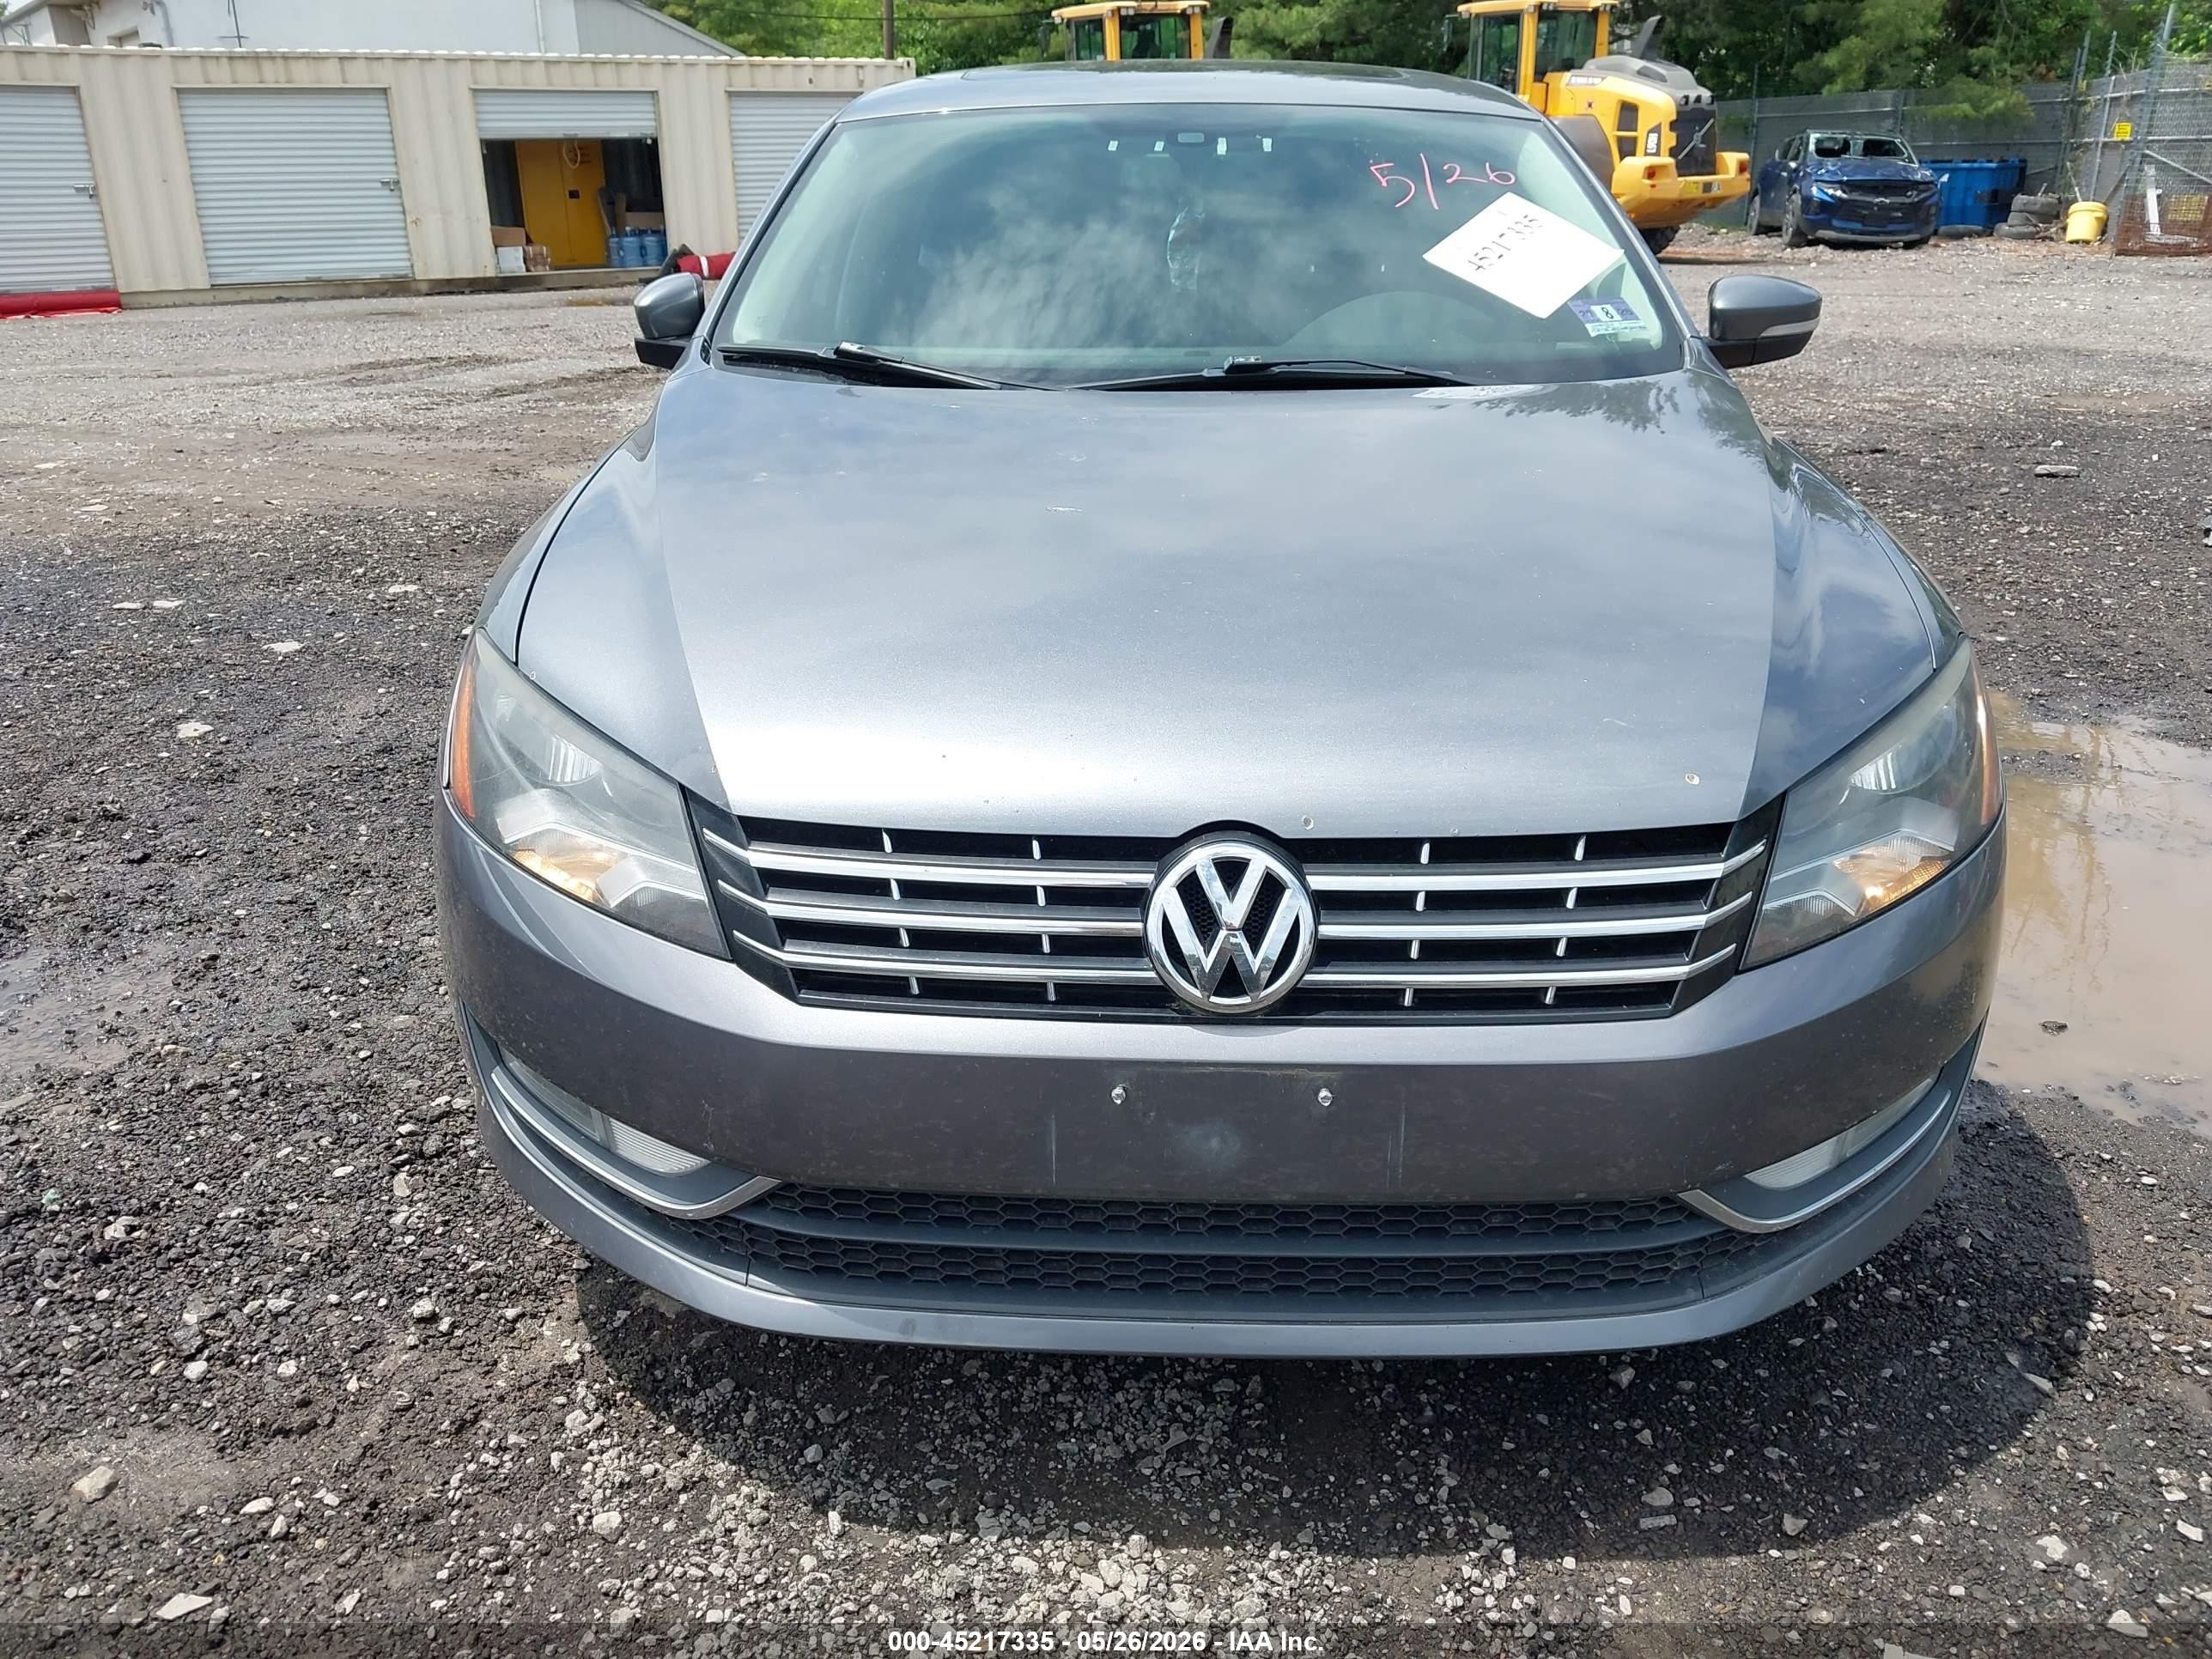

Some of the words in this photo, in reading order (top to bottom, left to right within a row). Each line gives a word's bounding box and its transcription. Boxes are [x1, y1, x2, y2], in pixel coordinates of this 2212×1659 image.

[1370, 153, 1516, 210] 5/26
[1601, 307, 1614, 319] 8
[1159, 856, 1304, 1003] VW
